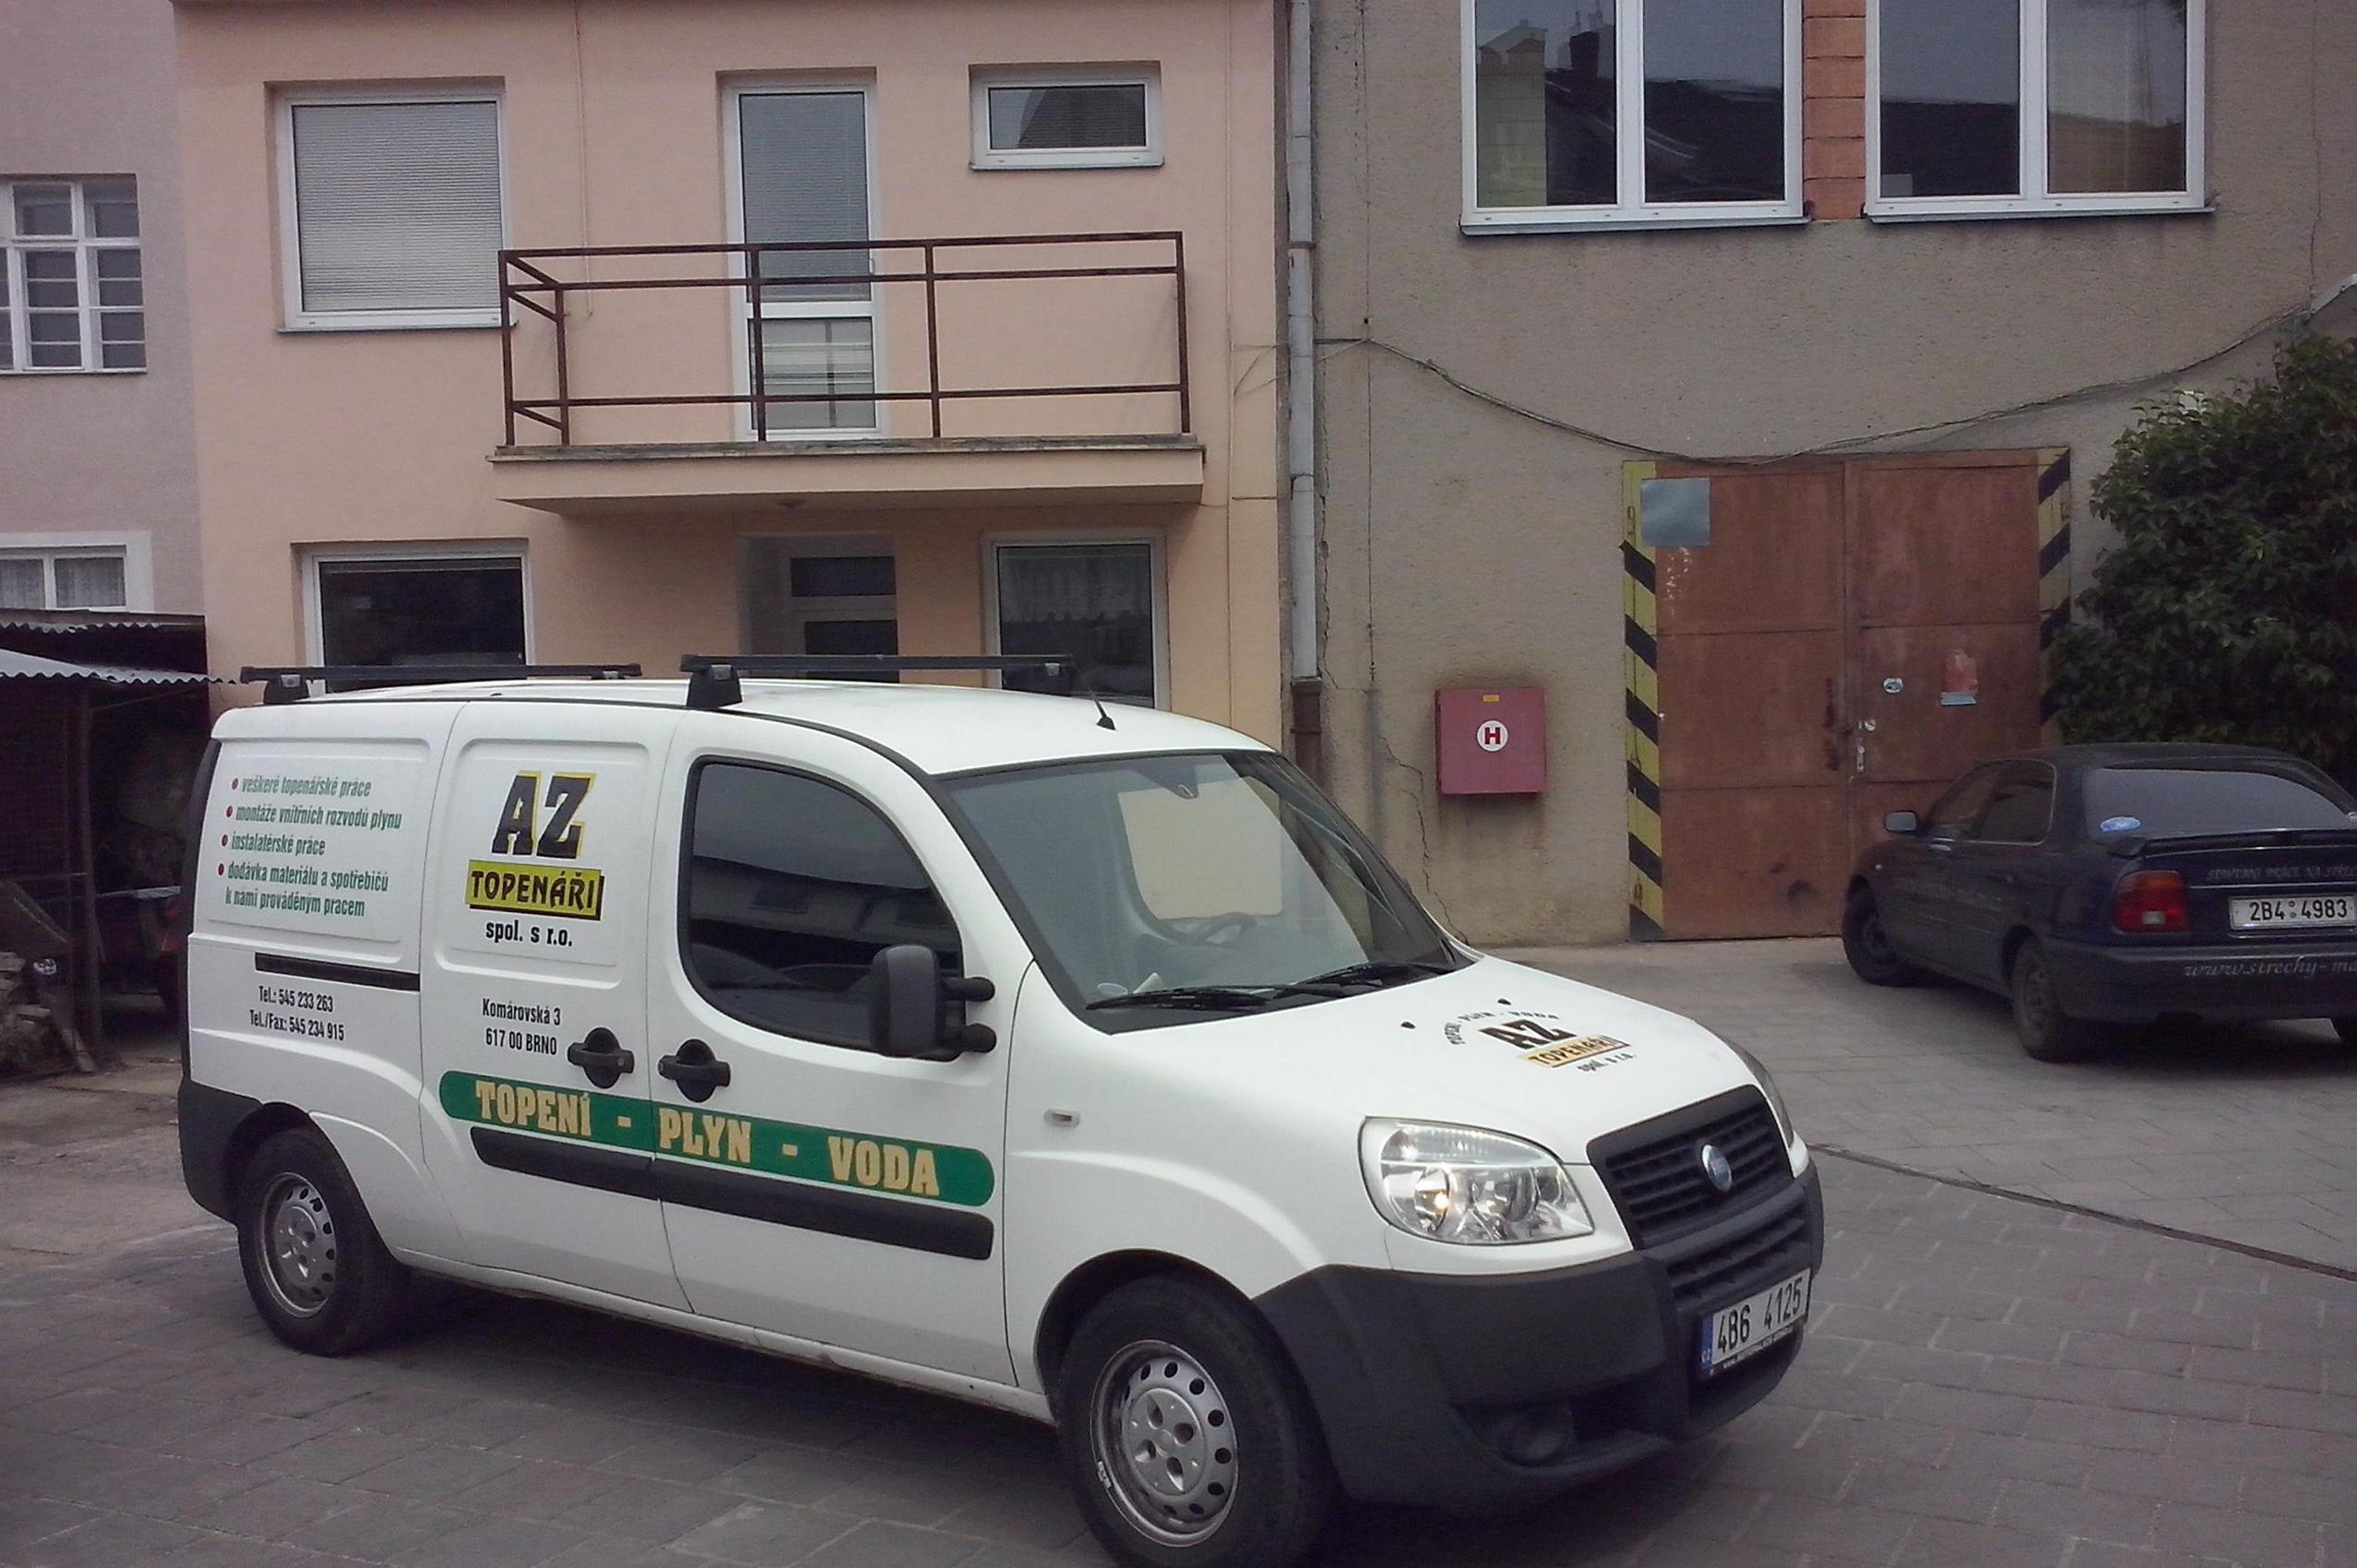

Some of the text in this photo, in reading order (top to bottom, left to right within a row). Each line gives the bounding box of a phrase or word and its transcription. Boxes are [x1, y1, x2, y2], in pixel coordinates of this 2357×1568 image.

[1484, 727, 1501, 744] H
[339, 778, 372, 798] práce
[236, 803, 276, 822] montáže
[370, 809, 402, 830] plynu
[491, 770, 597, 859] AZ
[231, 831, 326, 856] instalatérské práce
[228, 861, 267, 881] dodávka
[270, 865, 318, 885] materiálu
[321, 871, 327, 886] a
[225, 886, 365, 917] k námi prováděným pracem
[471, 870, 595, 911] TOPENÁŘI
[2249, 898, 2348, 921] 2B4 4983
[485, 920, 573, 946] spol. s r.o.
[279, 989, 295, 1006] 545
[298, 992, 314, 1009] 233
[316, 994, 333, 1013] 263
[482, 998, 561, 1026] Komárovská 3
[249, 1009, 344, 1040] Tel./Fax: 545 234 915
[1478, 1019, 1577, 1050] AZ
[486, 1028, 557, 1055] 617 00 BRNO
[475, 1080, 592, 1137] TOPENÍ
[660, 1108, 752, 1164] PLYN
[827, 1135, 940, 1196] VODA
[1718, 1304, 1751, 1353] 4B6
[1764, 1276, 1803, 1329] 4125
